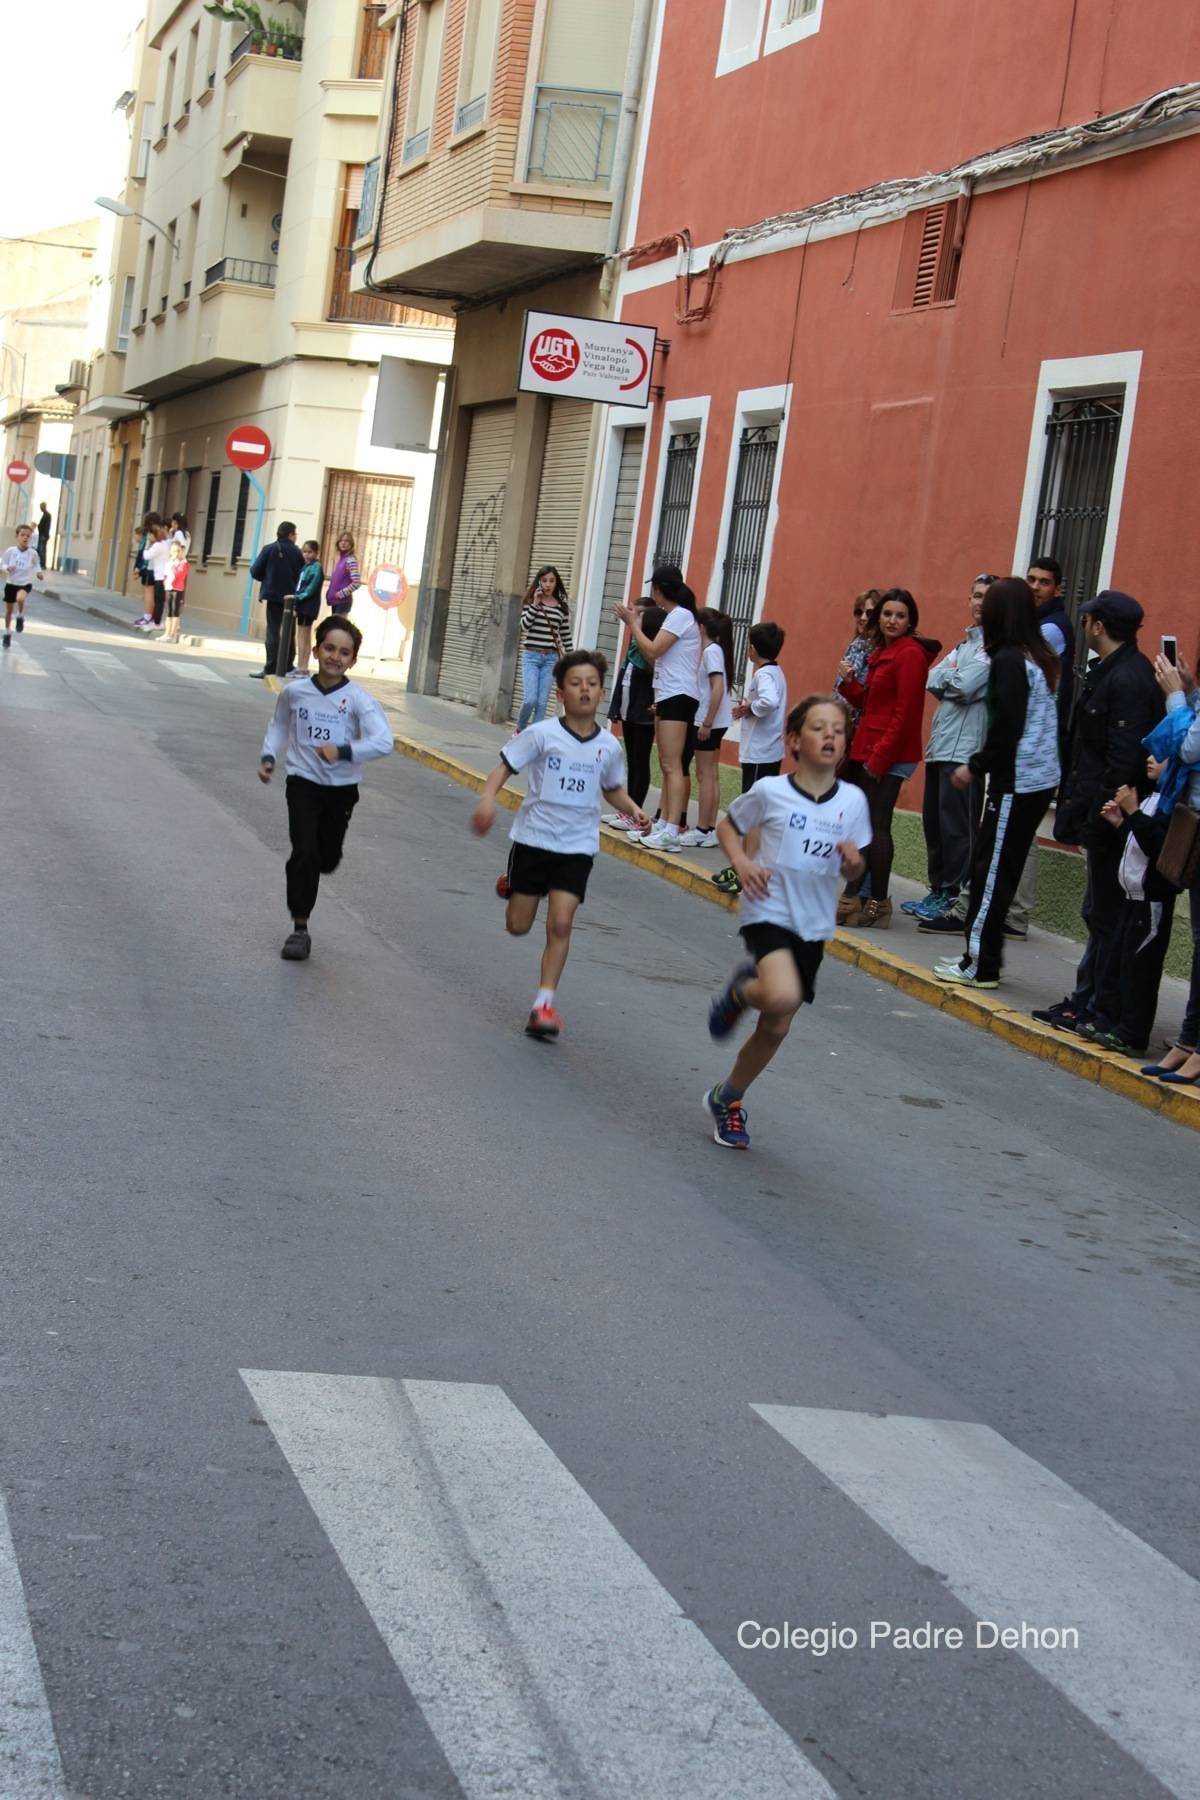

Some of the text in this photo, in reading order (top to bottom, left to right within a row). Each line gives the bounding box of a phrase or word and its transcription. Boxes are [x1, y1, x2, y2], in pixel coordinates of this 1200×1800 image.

[536, 335, 575, 359] UGT
[584, 342, 634, 356] Muntanya
[583, 361, 631, 374] Vega Baja
[307, 726, 331, 741] 123
[559, 776, 586, 793] 128
[802, 838, 833, 858] 122
